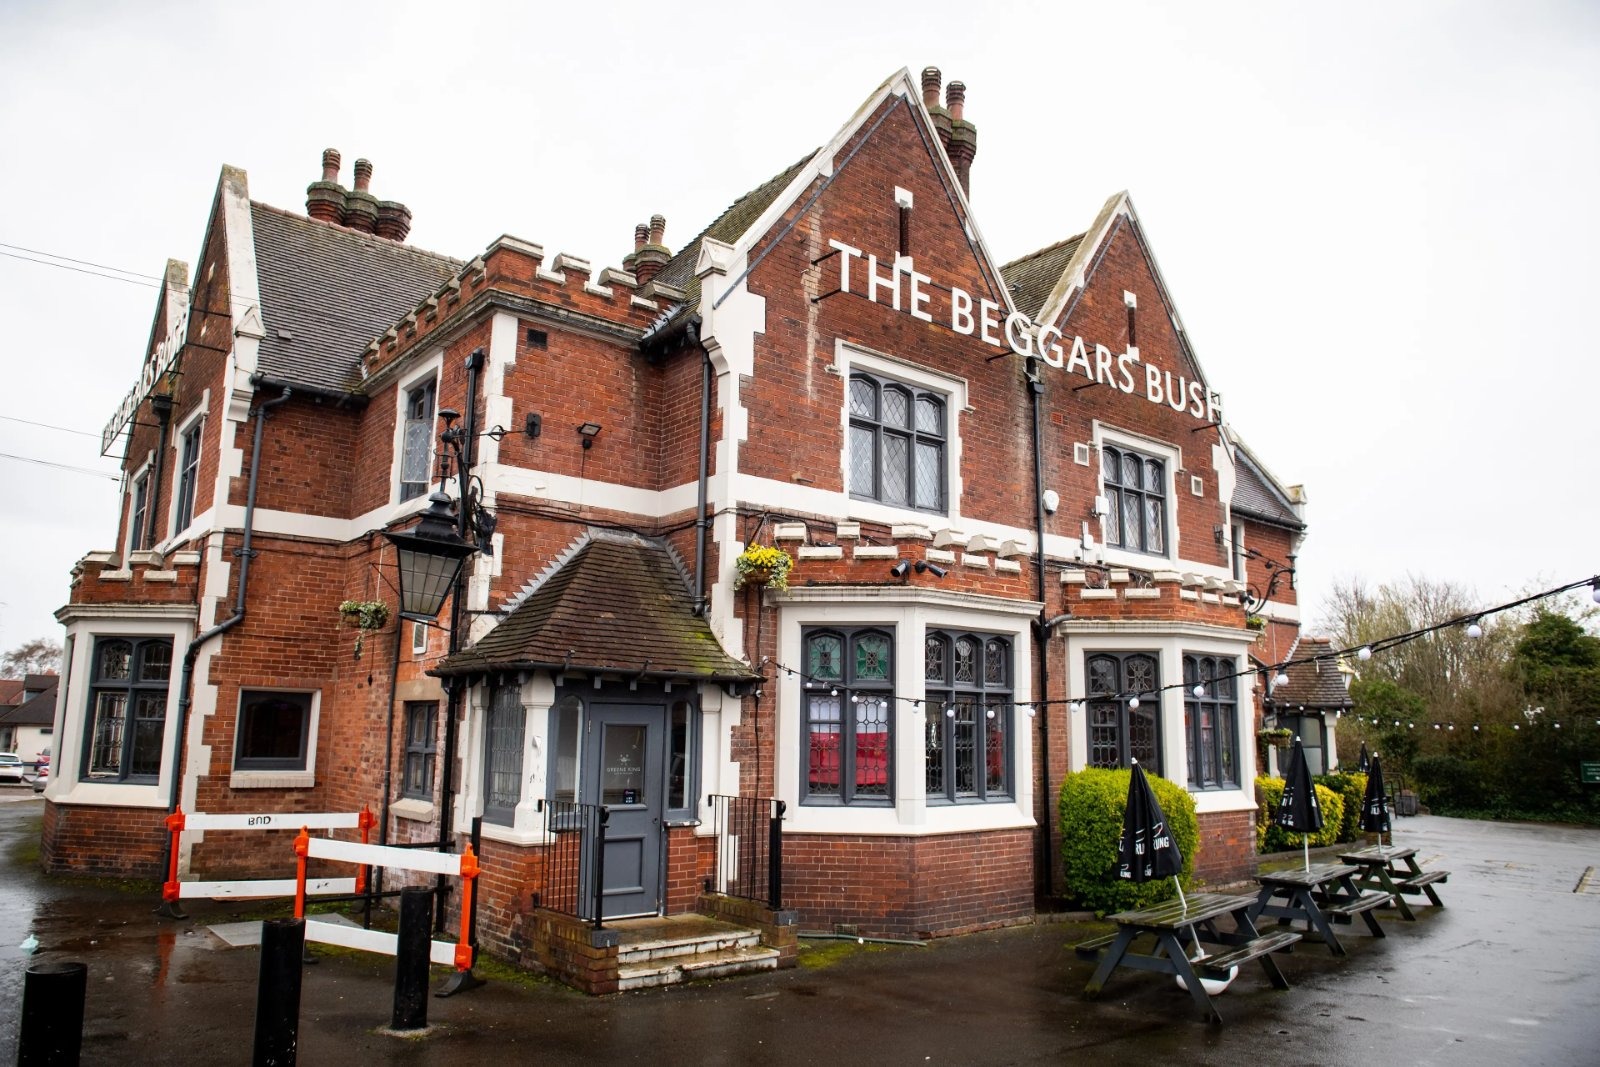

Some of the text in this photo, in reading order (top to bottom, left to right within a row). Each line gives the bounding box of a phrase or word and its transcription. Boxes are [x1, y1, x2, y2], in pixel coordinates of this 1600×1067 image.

[828, 238, 1223, 426] THE BEGGARS BUSH
